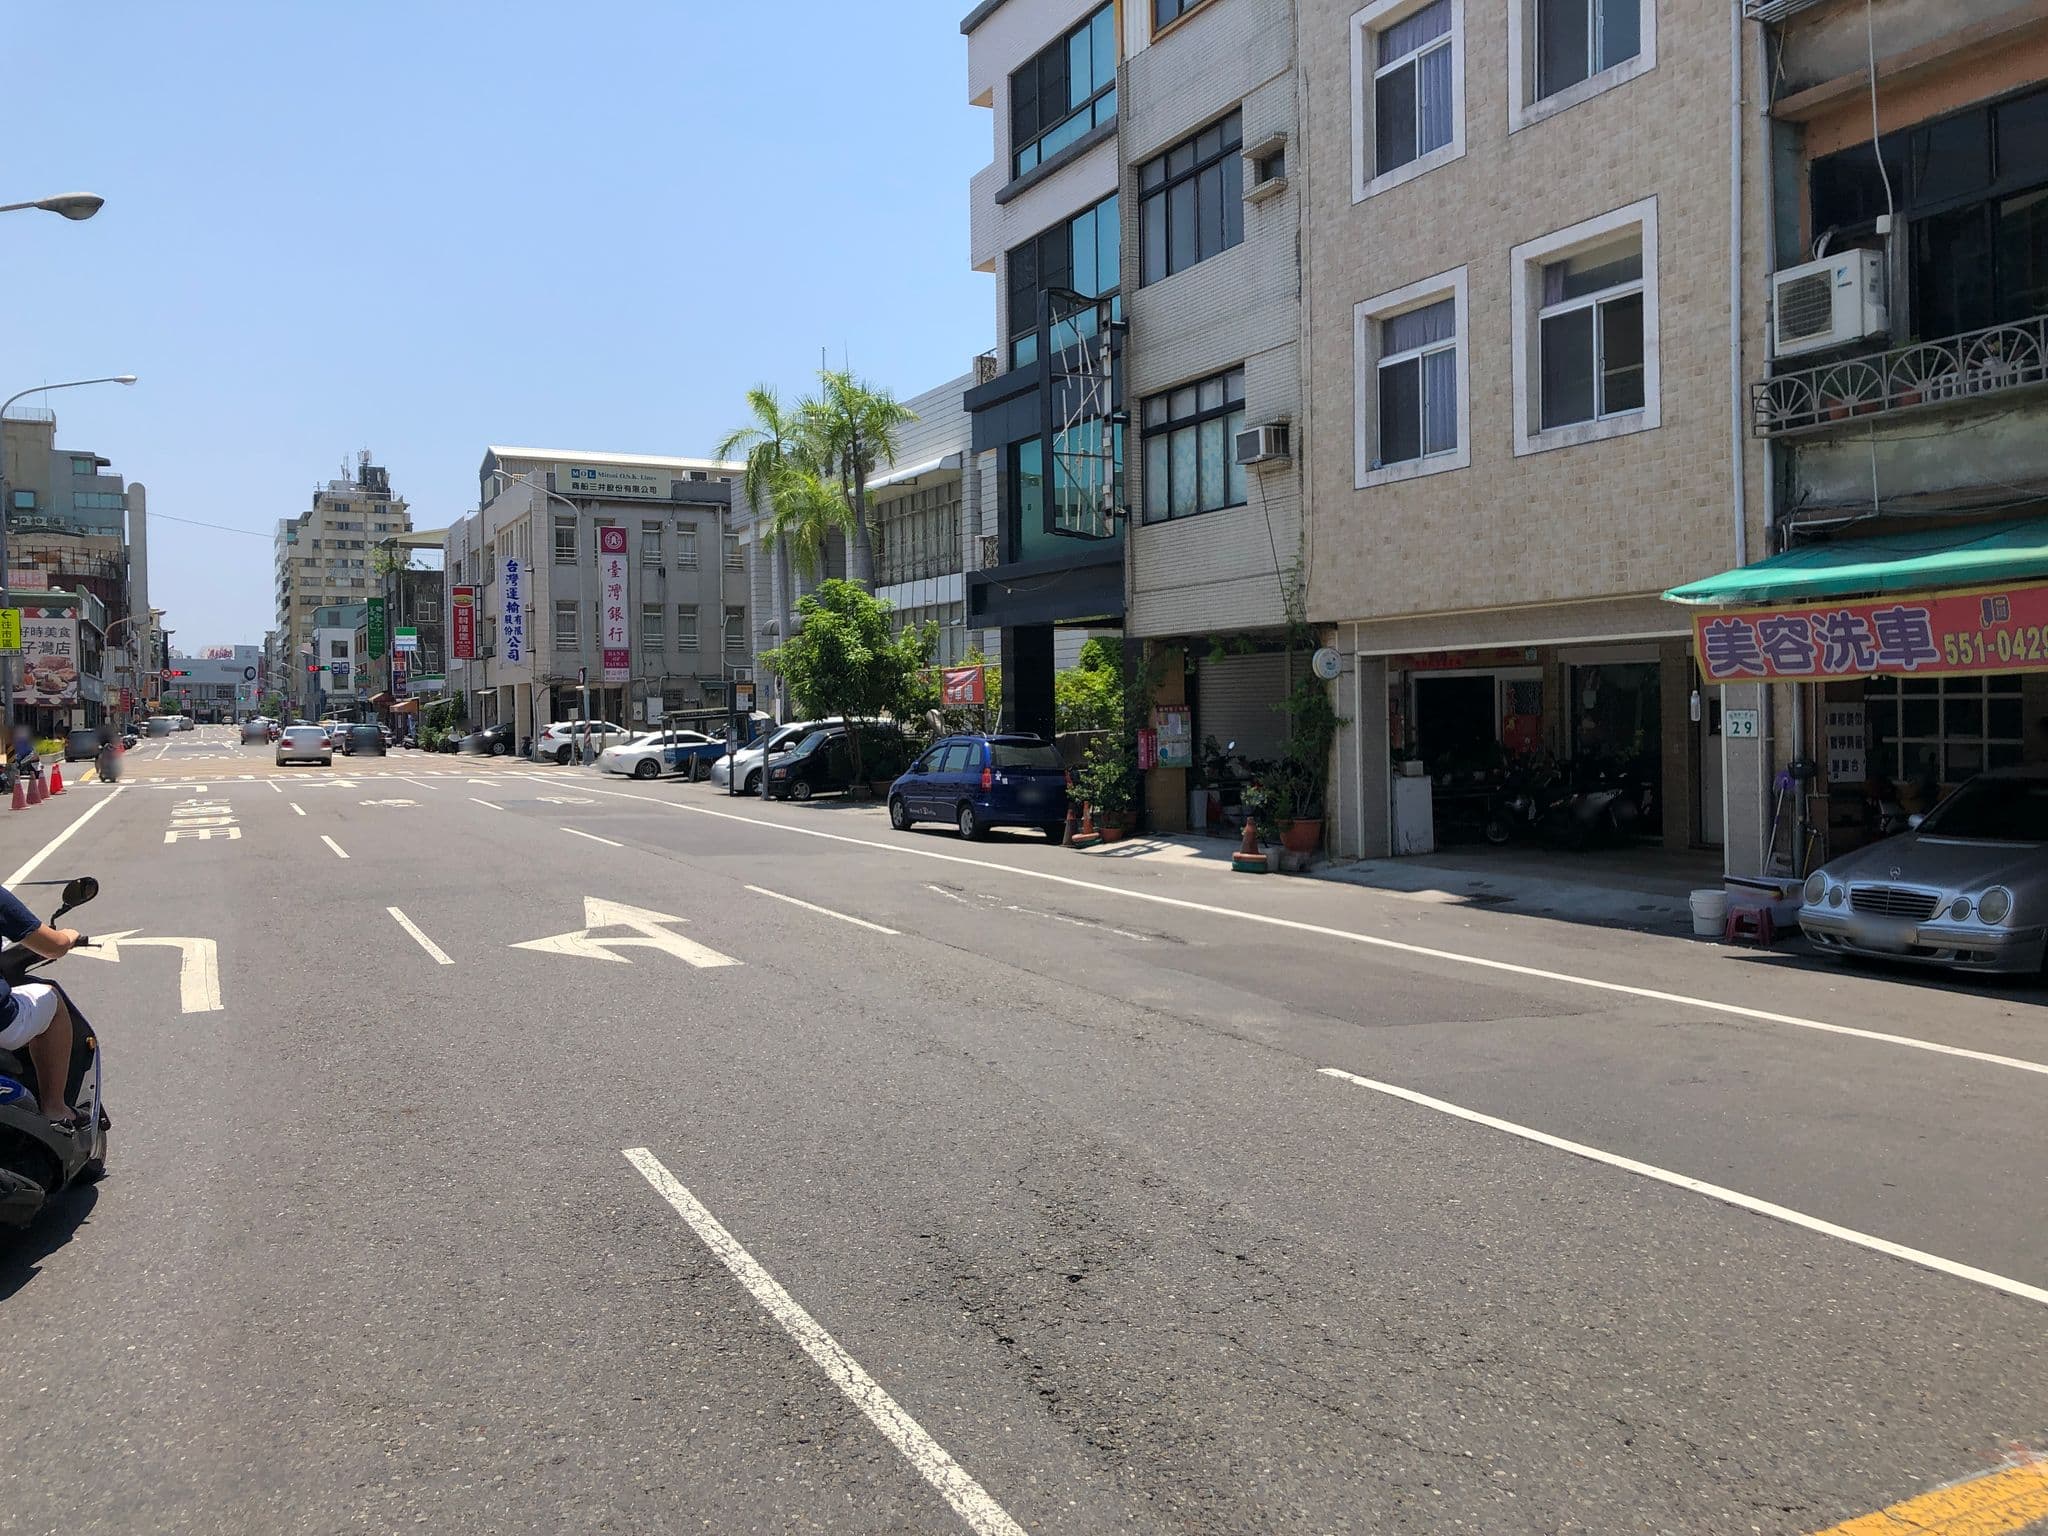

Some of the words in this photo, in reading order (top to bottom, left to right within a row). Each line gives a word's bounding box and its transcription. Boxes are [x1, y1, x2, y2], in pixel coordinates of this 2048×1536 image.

[607, 560, 624, 642] 臺灣銀行
[20, 626, 71, 638] 好時美食
[1705, 607, 1940, 677] 美容洗車
[1732, 721, 1752, 735] 29
